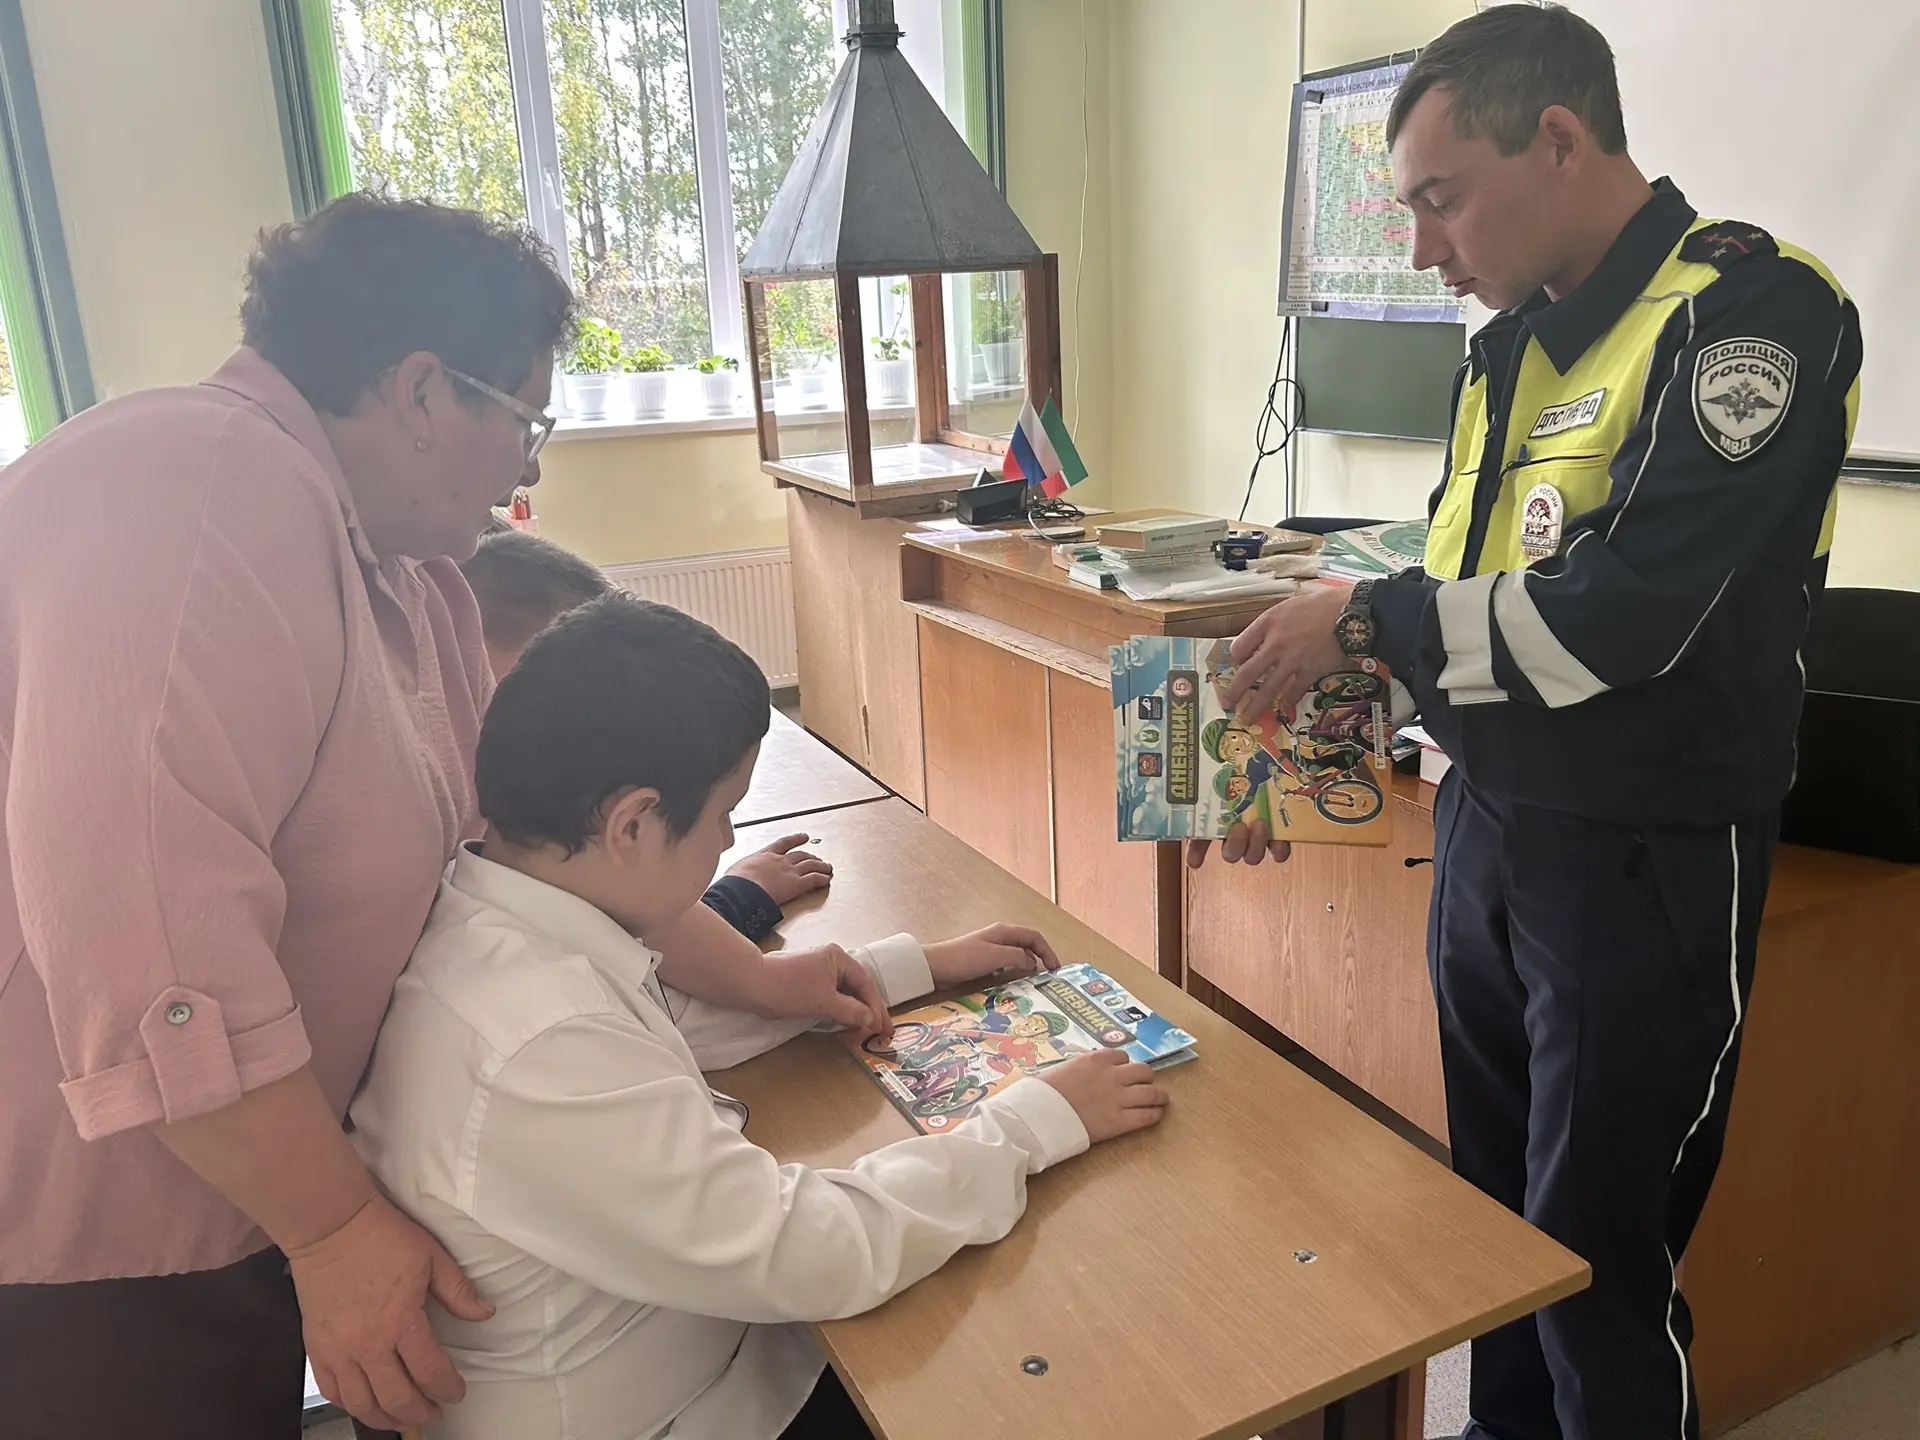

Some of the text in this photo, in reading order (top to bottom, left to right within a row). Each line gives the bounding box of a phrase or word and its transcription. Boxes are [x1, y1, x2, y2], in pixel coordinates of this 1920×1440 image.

[1705, 344, 1790, 372] ПОЛИЦИЯ
[1708, 363, 1781, 392] РОССИЯ
[1535, 409, 1564, 431] ДПС
[1719, 433, 1751, 455] МВД
[1171, 682, 1188, 799] ДНЕВНИК 5
[1047, 980, 1115, 1032] ДНЕВНИК
[1109, 1031, 1121, 1040] 5
